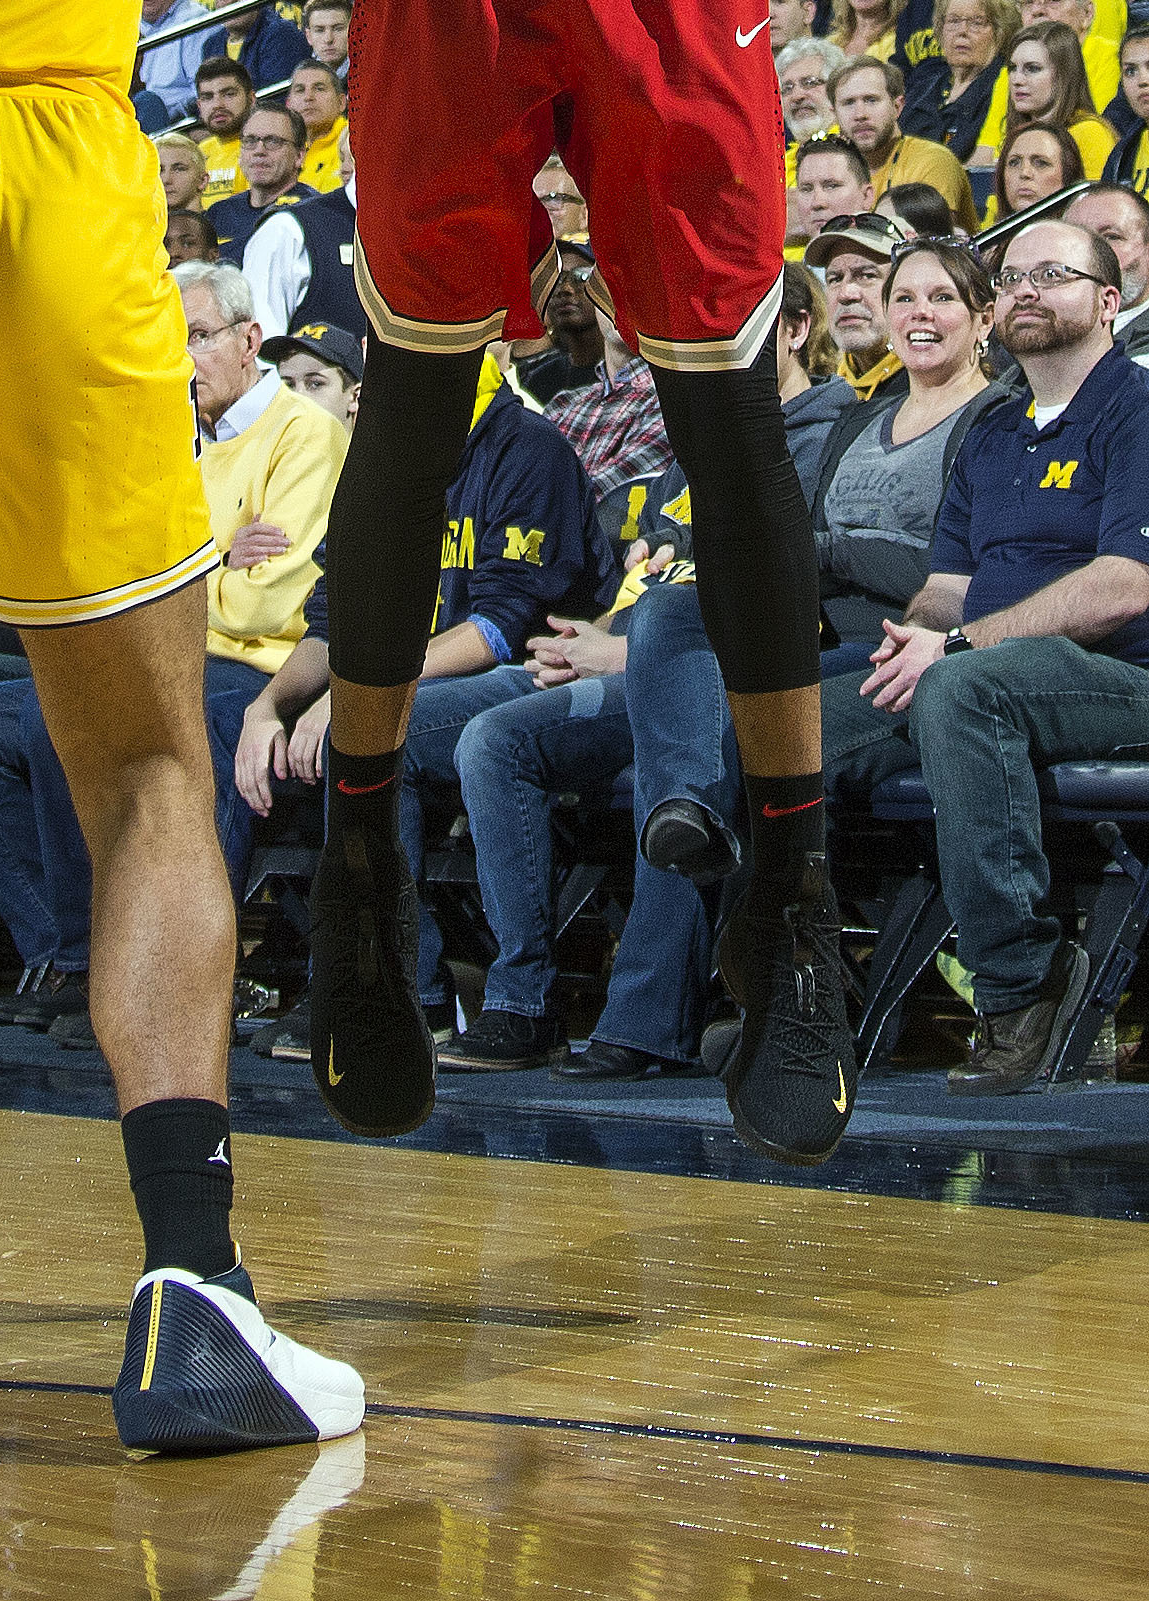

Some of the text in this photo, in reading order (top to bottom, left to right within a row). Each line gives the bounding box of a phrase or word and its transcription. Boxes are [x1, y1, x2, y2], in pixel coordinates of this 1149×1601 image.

[295, 323, 327, 340] M
[1040, 461, 1079, 489] M
[503, 526, 545, 567] M
